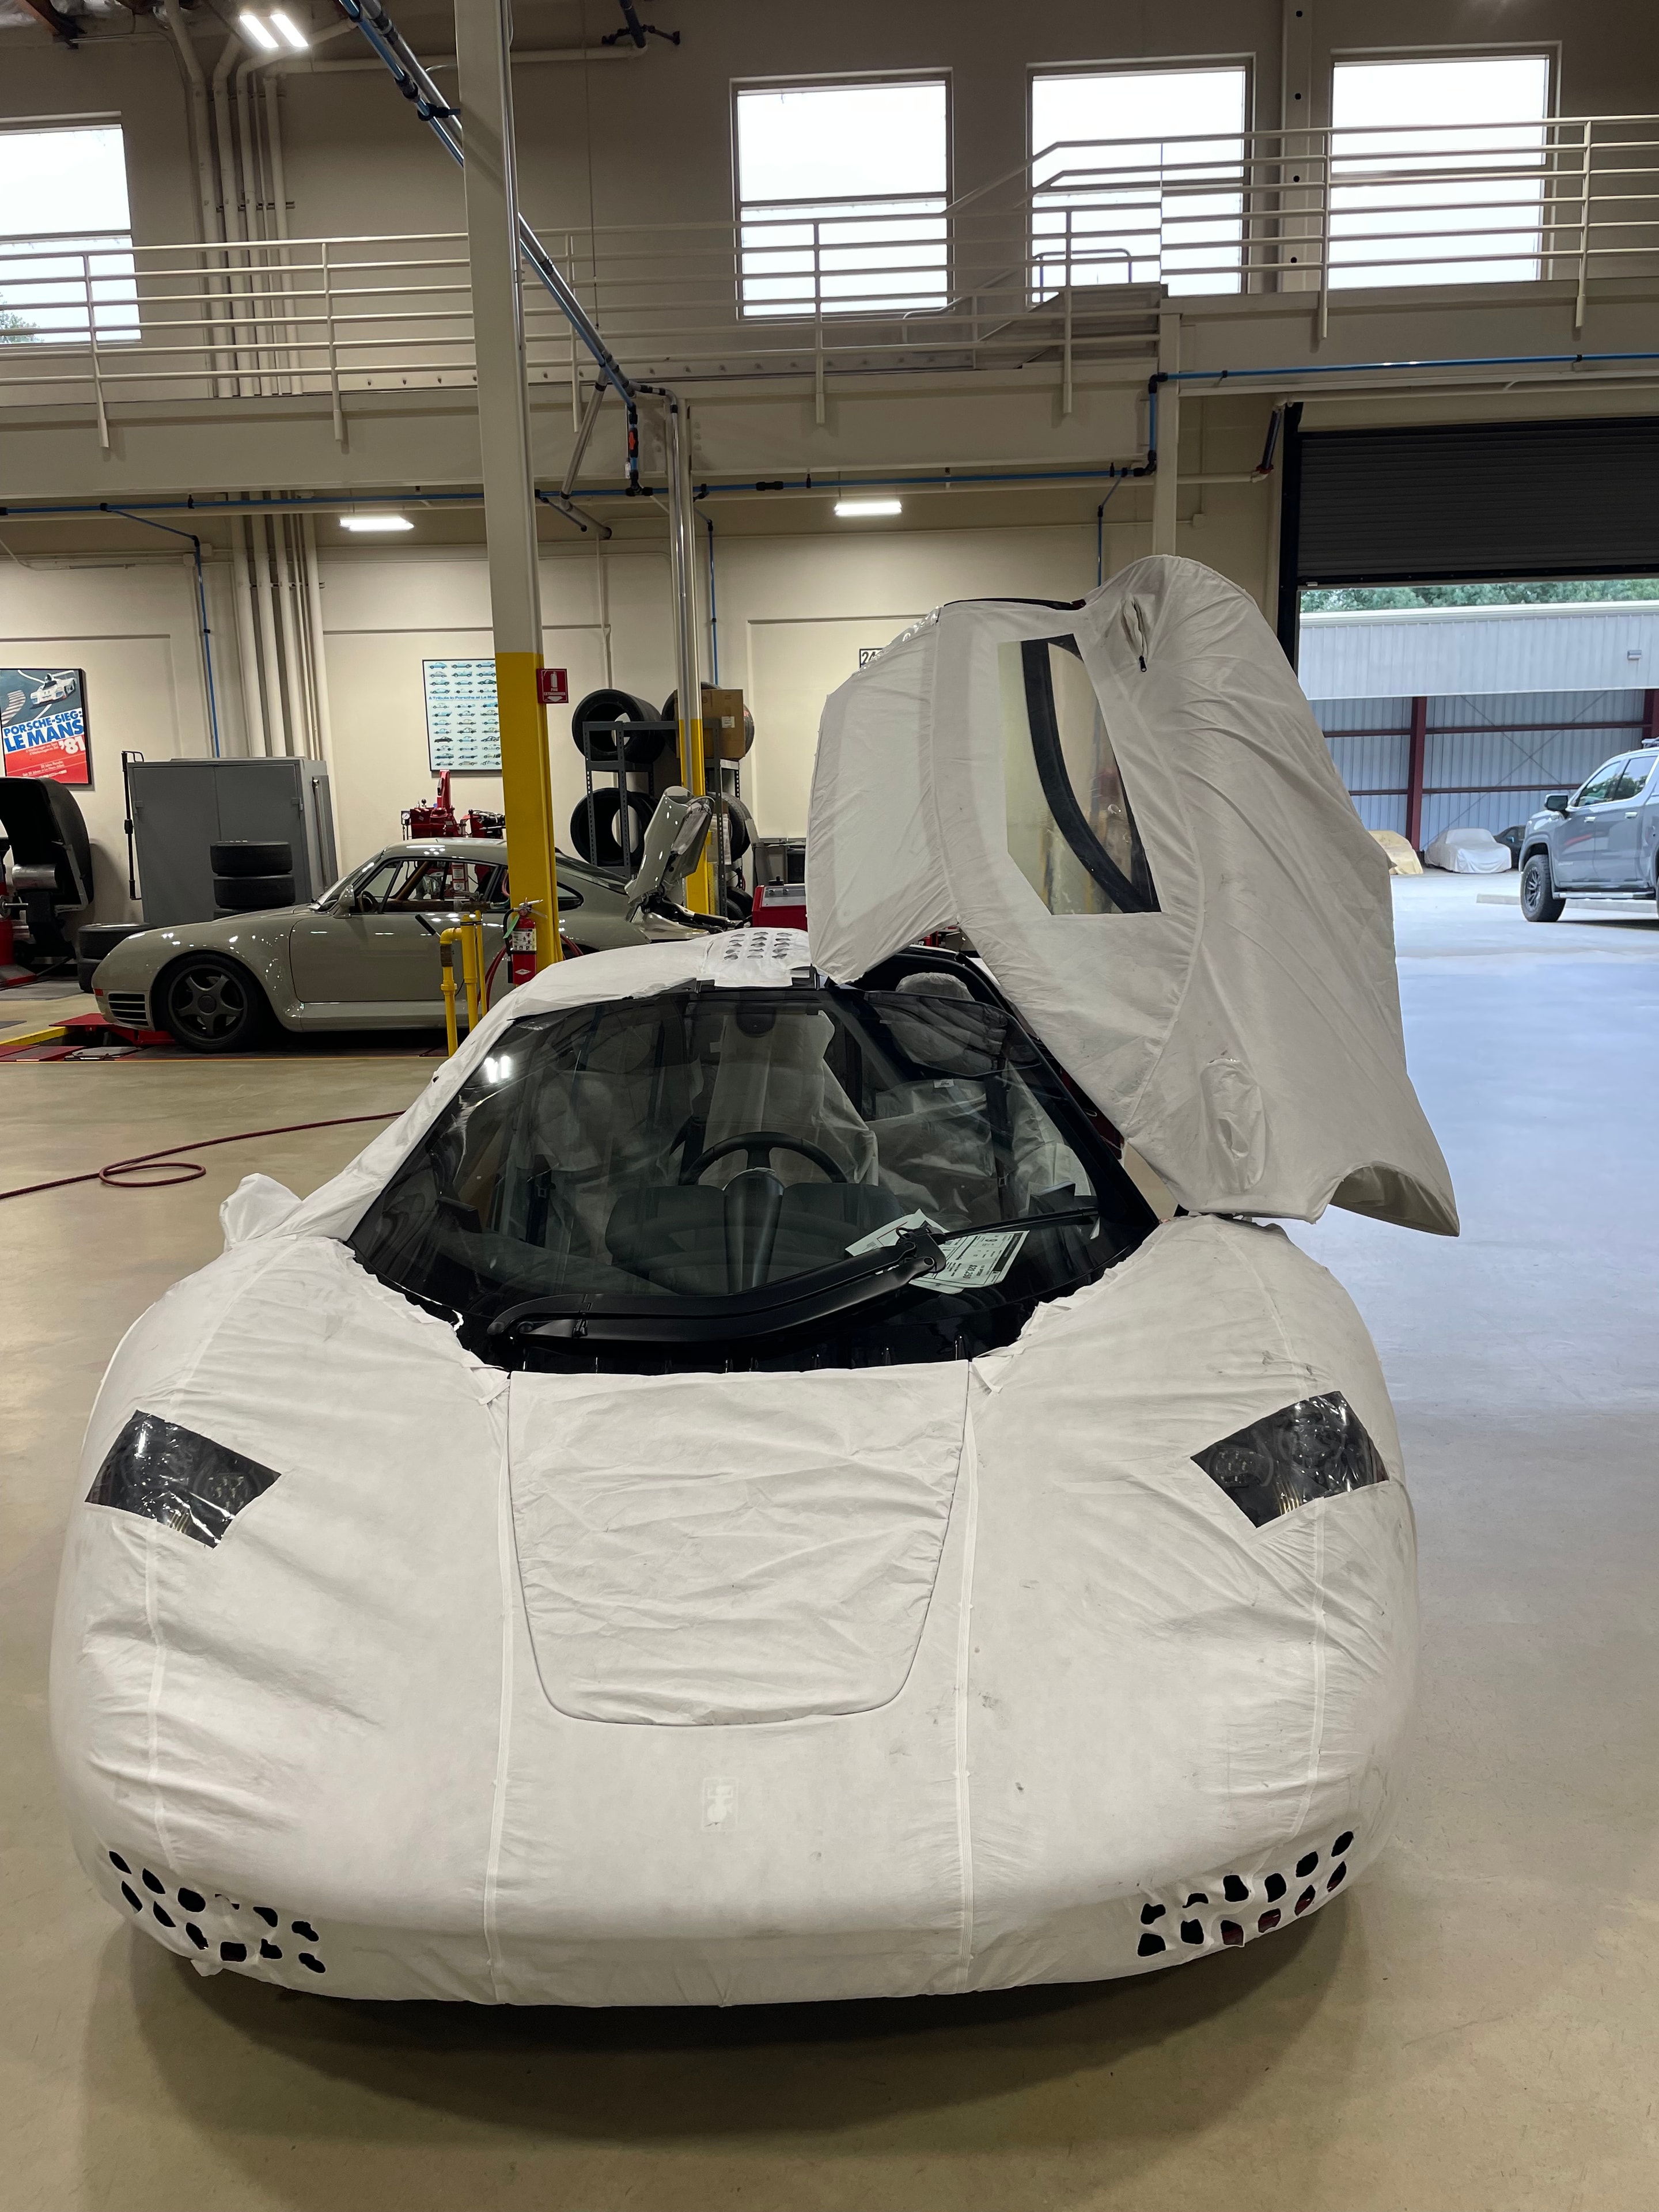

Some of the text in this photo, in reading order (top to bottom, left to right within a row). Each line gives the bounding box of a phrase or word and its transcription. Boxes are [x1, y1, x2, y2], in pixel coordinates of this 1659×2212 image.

[3, 711, 83, 737] PORSCHE-SIEG:
[4, 734, 26, 752] LE
[27, 719, 84, 747] MANS
